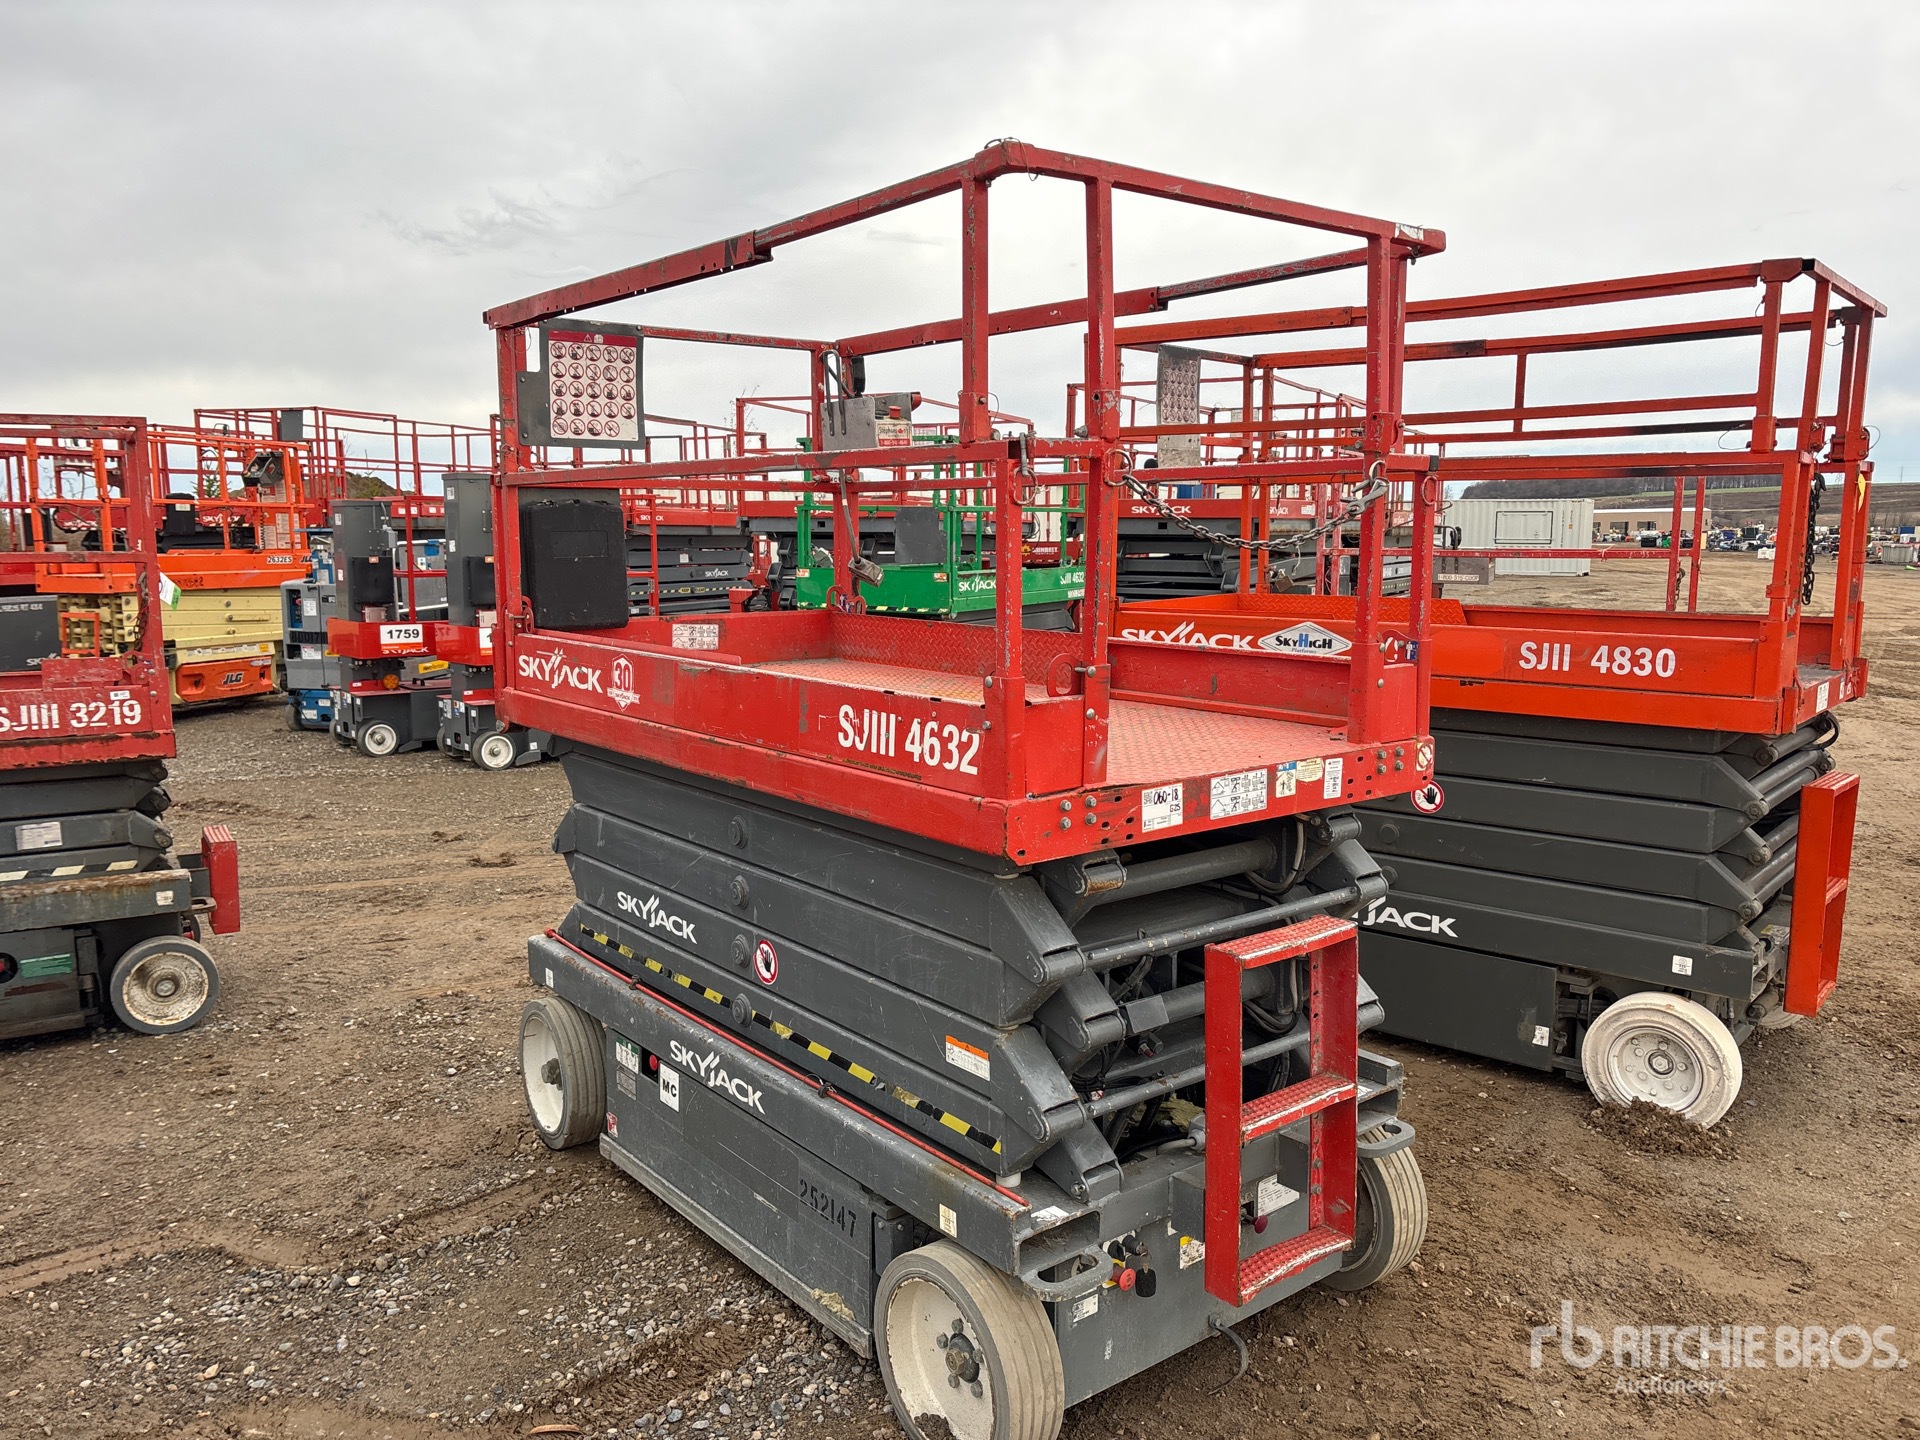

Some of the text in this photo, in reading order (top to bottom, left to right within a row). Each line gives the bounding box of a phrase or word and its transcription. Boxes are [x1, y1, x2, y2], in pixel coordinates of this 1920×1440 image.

[387, 628, 420, 639] 1759
[222, 671, 244, 685] JLG
[518, 647, 603, 693] SKYJACK
[615, 661, 630, 691] 30
[1590, 645, 1676, 678] 4830
[69, 700, 141, 728] 3219
[838, 704, 980, 776] SJIII 4632
[617, 890, 697, 945] SKYJACK
[1361, 896, 1459, 938] JACK
[662, 1078, 677, 1098] MC
[669, 1039, 765, 1115] SKYJACK
[800, 1178, 857, 1238] 252147
